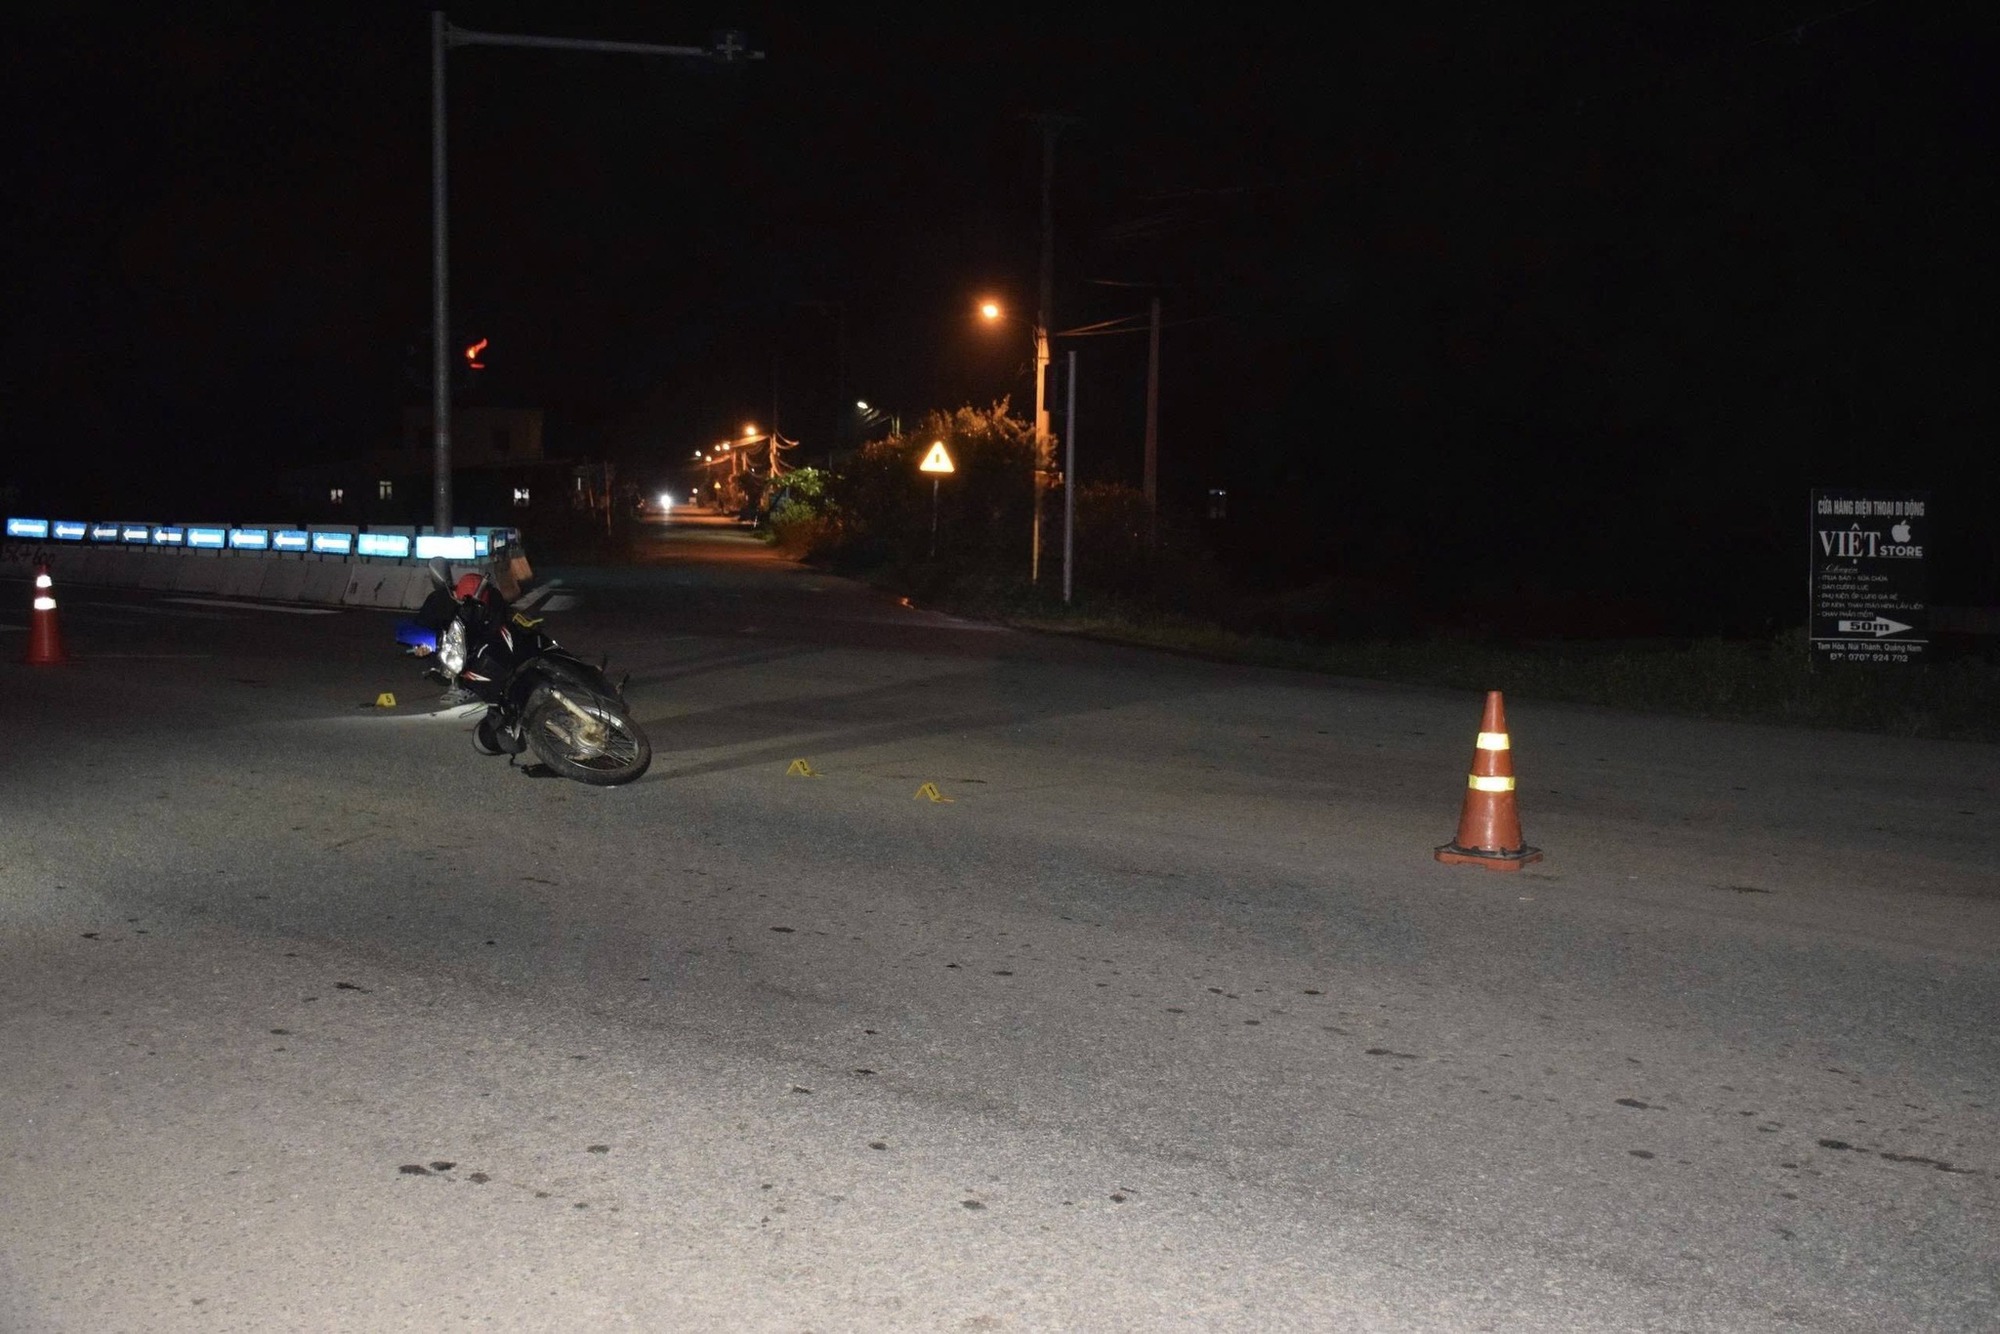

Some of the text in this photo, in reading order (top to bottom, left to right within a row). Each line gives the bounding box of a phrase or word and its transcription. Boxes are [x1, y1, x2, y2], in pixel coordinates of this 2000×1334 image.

[1834, 497, 1854, 515] HÀNG
[1855, 498, 1872, 519] ĐIỆN
[1873, 501, 1894, 519] THOẠI
[1895, 501, 1903, 516] DI
[1904, 498, 1925, 520] ĐỘNG
[1819, 523, 1881, 564] VIỆT
[1880, 545, 1923, 557] STORE
[1850, 622, 1889, 631] 50m
[1817, 642, 1831, 650] Tam
[1907, 644, 1922, 652] Nam
